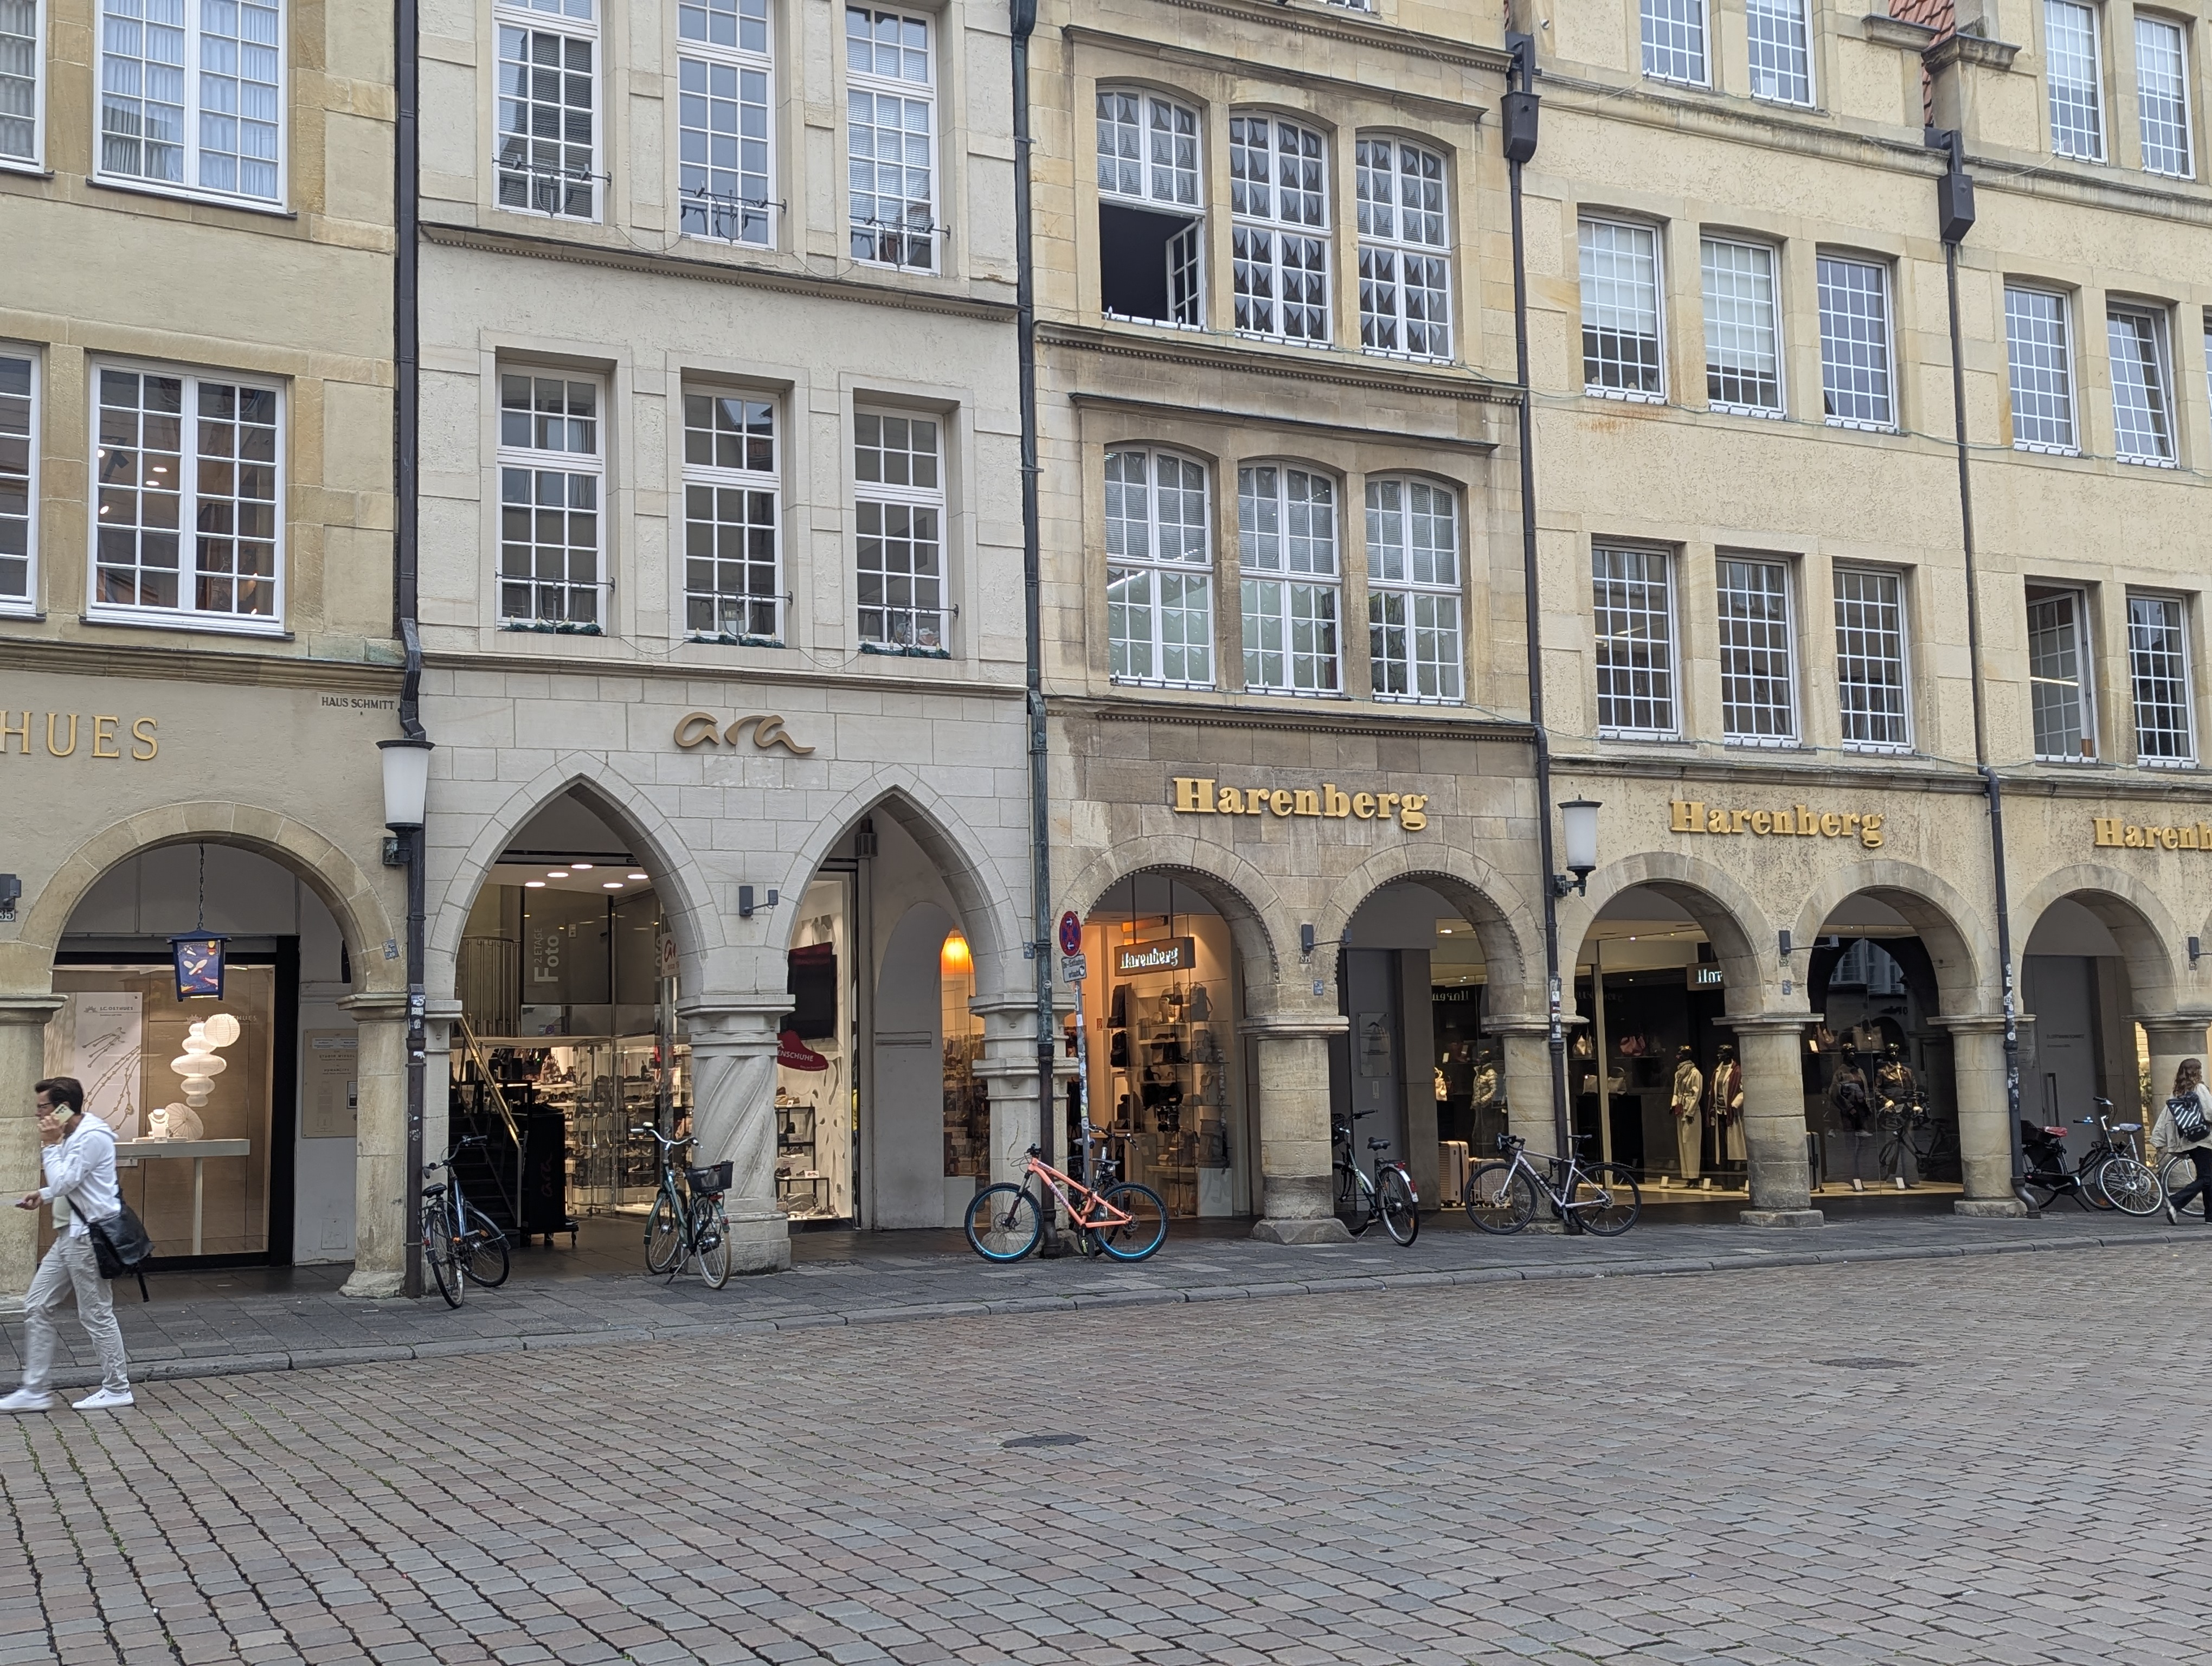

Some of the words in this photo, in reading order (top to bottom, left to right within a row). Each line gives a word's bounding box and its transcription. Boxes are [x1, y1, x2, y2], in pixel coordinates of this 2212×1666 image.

[321, 697, 348, 707] HAUS
[351, 699, 395, 709] SCHMITT
[674, 712, 816, 754] ara
[1173, 777, 1427, 831] Harenberg
[1670, 801, 1884, 848] Harenberg
[534, 935, 559, 982] Foto
